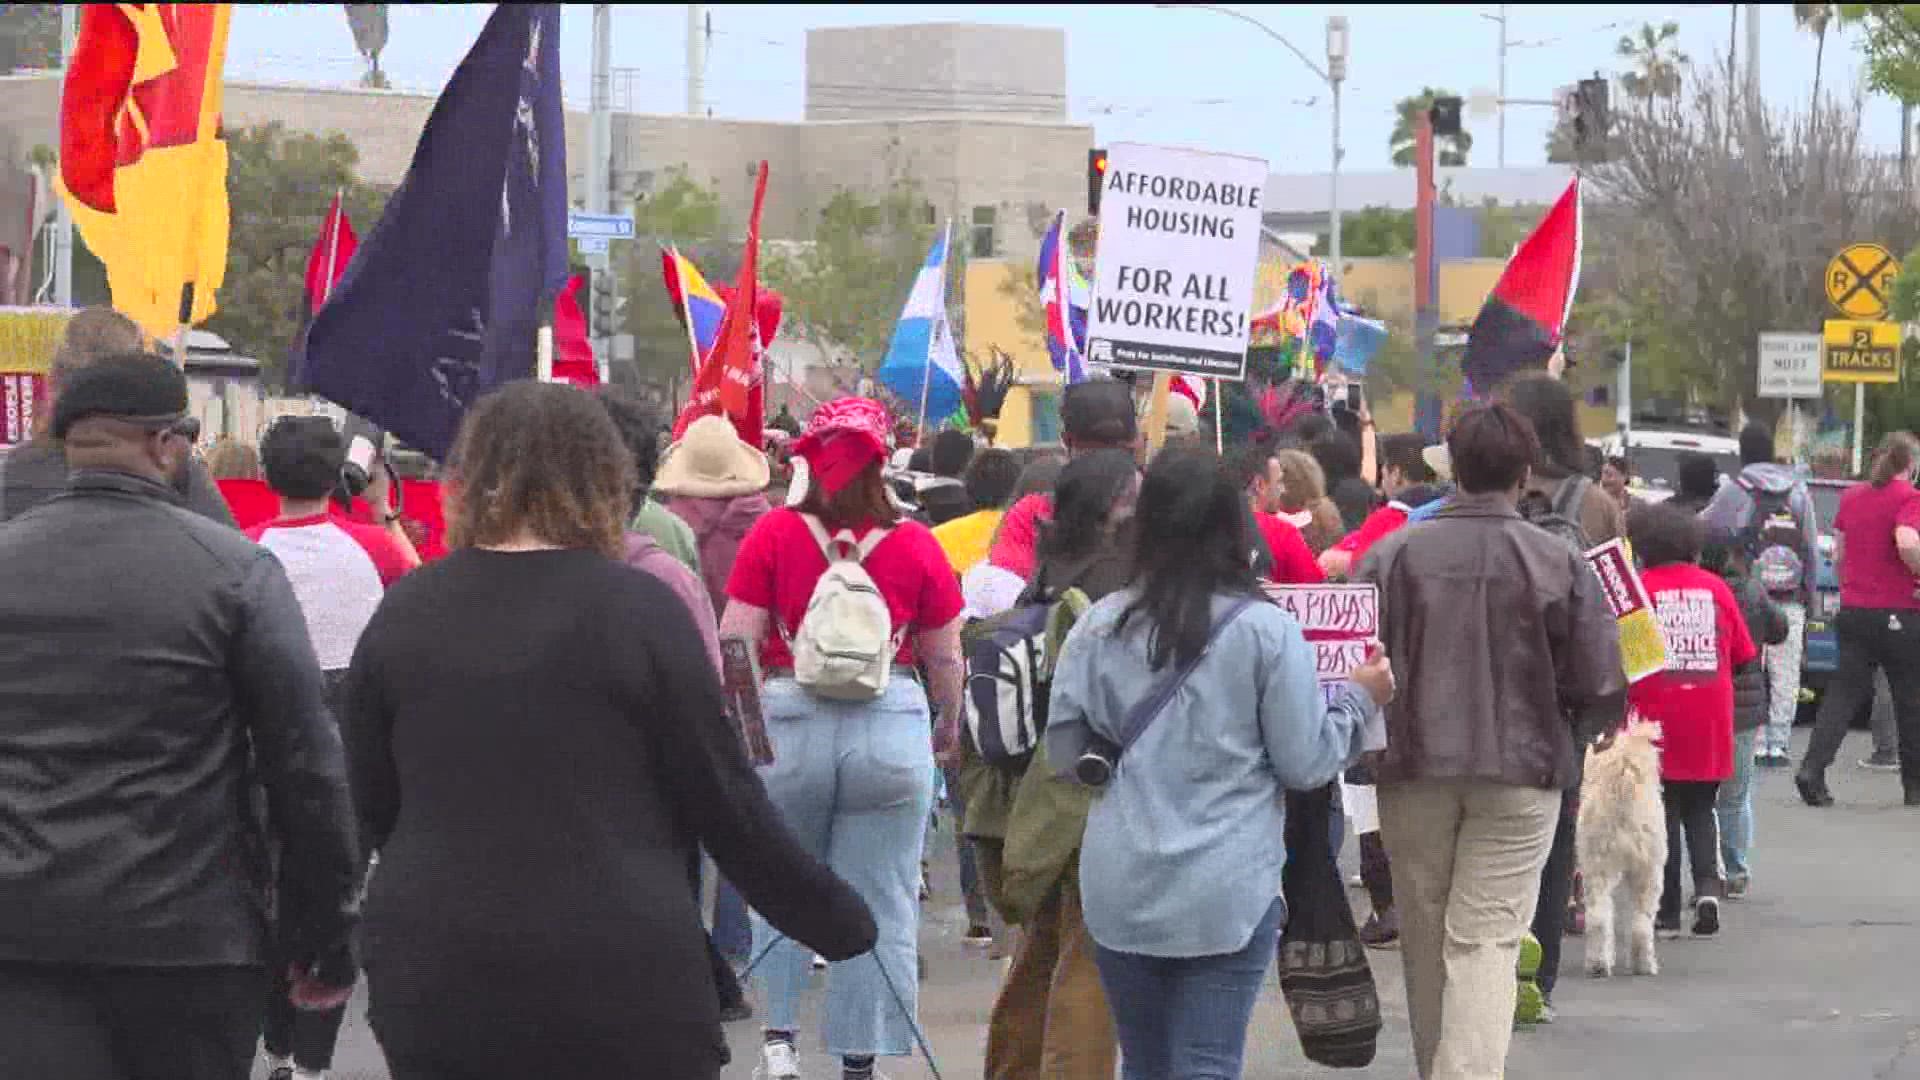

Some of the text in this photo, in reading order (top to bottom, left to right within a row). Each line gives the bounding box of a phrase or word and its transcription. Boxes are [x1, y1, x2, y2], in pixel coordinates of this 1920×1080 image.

[1108, 170, 1262, 209] AFFORDABLE
[1127, 205, 1235, 240] HOUSING
[1118, 265, 1230, 302] FOR ALL
[1833, 271, 1848, 289] R
[1097, 297, 1244, 338] WORKERS!
[1855, 331, 1869, 349] 2
[1831, 352, 1892, 368] TRACKS
[1305, 592, 1373, 630] PINAS
